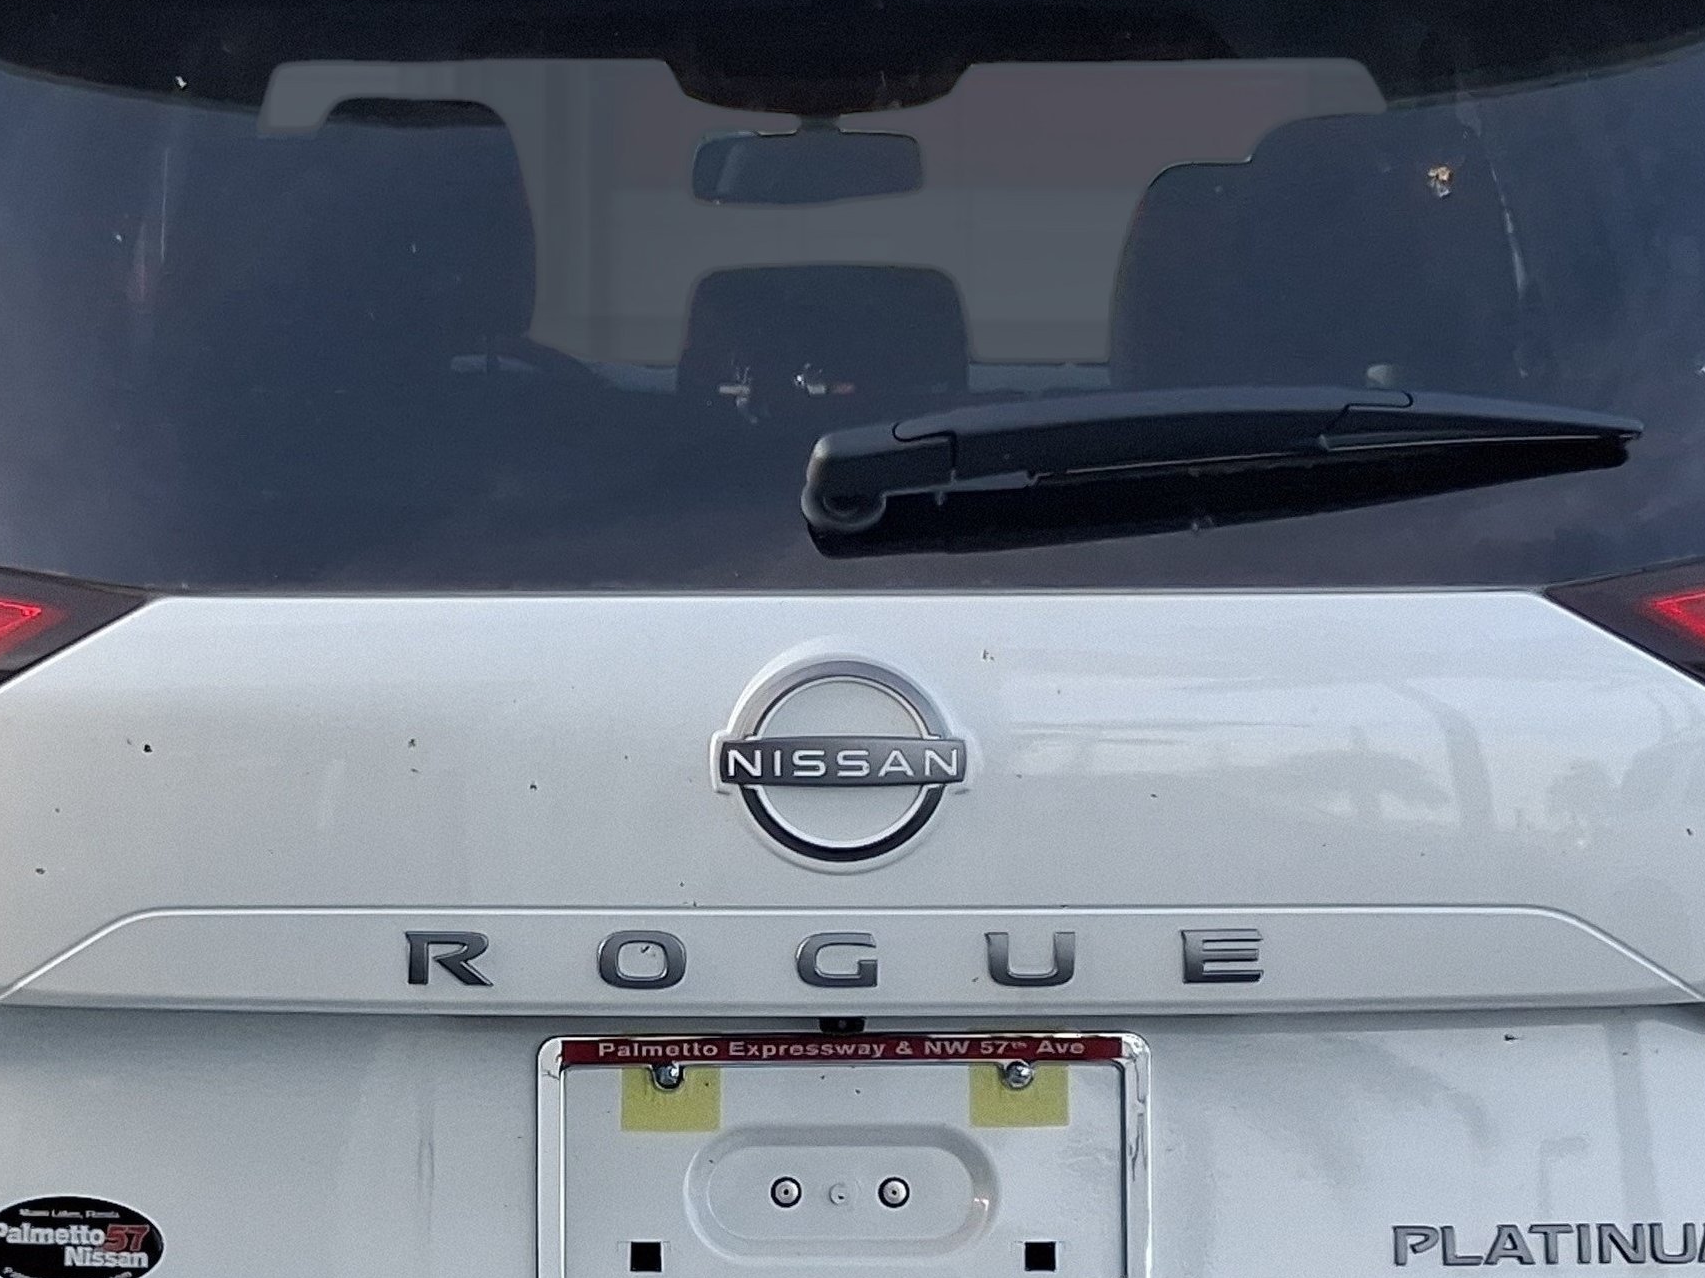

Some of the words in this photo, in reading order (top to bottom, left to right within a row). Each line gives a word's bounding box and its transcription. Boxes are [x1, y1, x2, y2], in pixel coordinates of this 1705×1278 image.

[727, 748, 959, 778] NISSAN
[405, 928, 1266, 989] ROGUE
[598, 1041, 718, 1058] Palmetto
[729, 1041, 886, 1059] Expressway
[895, 1041, 913, 1055] &
[924, 1041, 969, 1055] NW
[1036, 1040, 1086, 1054] Ave
[64, 1246, 148, 1268] Nissan
